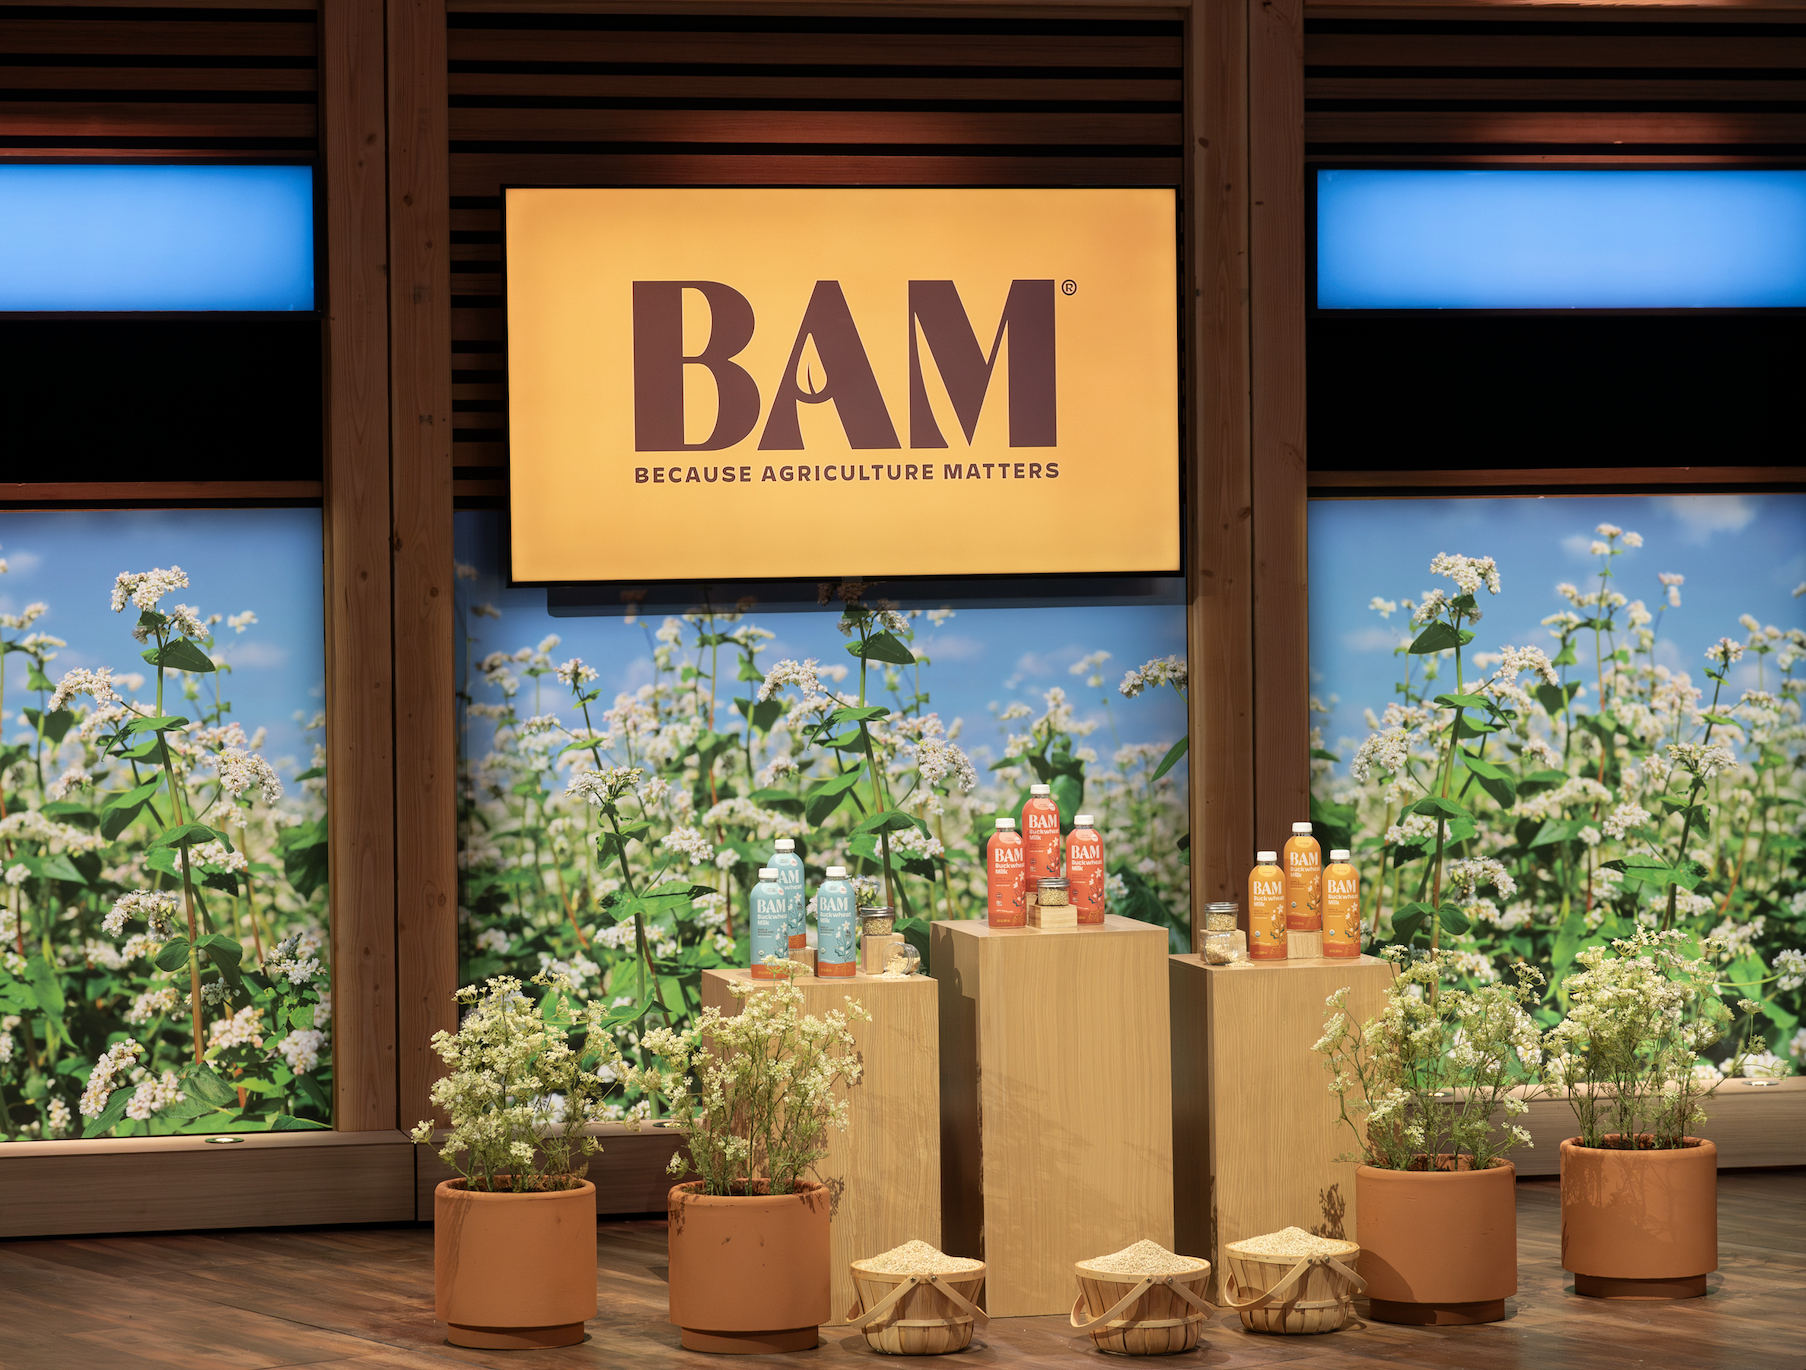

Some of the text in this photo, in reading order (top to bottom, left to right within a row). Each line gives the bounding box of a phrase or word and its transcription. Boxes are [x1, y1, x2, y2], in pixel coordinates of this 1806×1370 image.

[634, 462, 1060, 484] BECAUSE AGRICULTURE MATTERS
[1028, 814, 1058, 829] BAM
[994, 848, 1023, 862] BAM
[1071, 845, 1100, 859] BAM
[1290, 852, 1319, 866] BAM
[780, 870, 800, 884] AM
[1253, 881, 1282, 895] BAM
[1327, 879, 1357, 893] BAM
[757, 899, 786, 914] BAM
[819, 897, 849, 911] BAM
